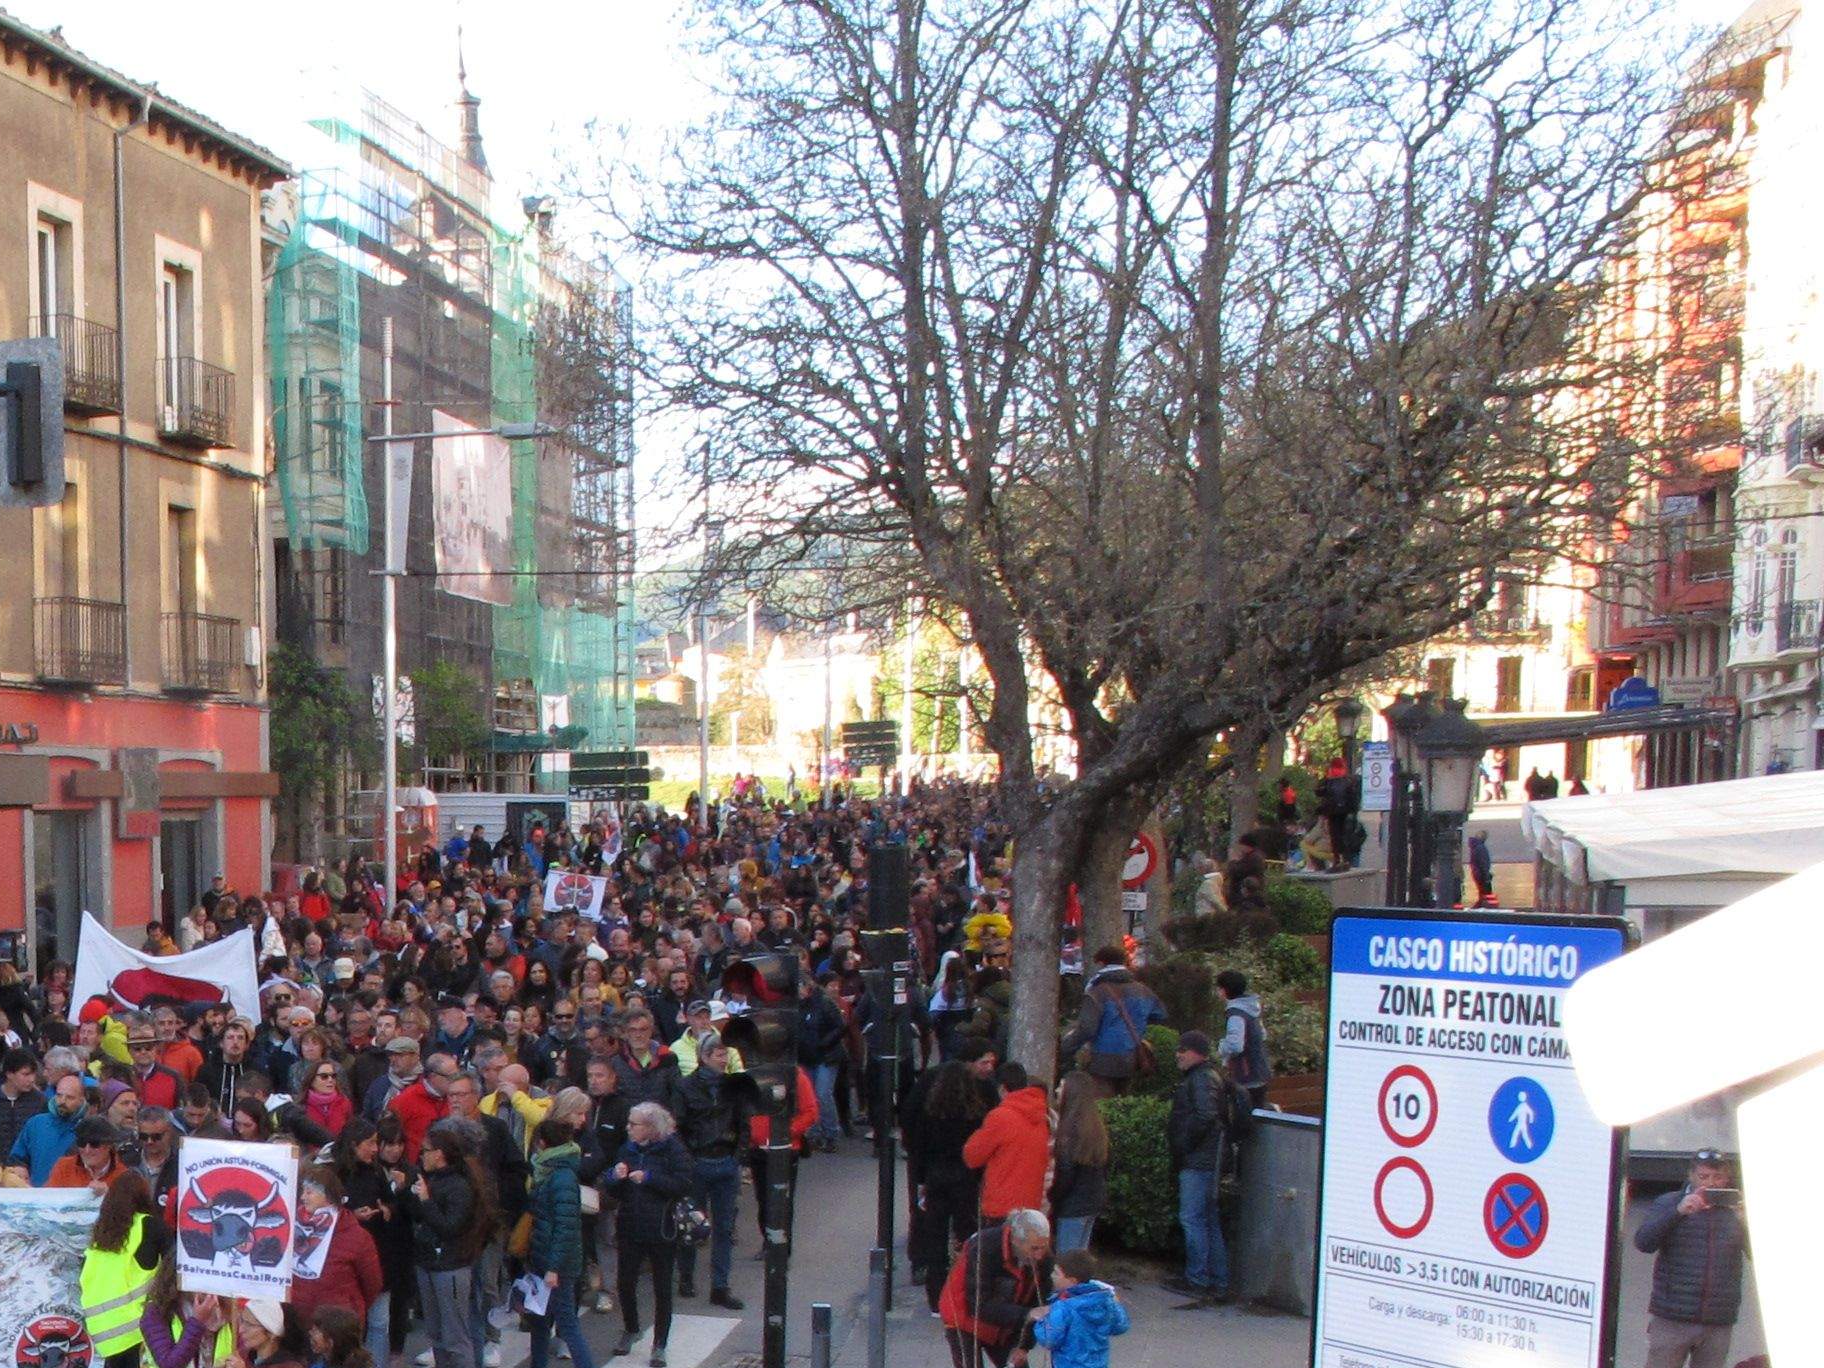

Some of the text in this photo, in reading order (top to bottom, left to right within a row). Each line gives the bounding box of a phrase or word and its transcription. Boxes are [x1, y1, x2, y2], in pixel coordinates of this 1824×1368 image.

[1369, 935, 1578, 980] CASCO HISTÓRICO
[1378, 984, 1561, 1028] ZONA PEATONAL
[1339, 1020, 1573, 1060] CONTROL DE ACCESO CON CÁMA
[1392, 1092, 1420, 1121] 10
[1331, 1243, 1402, 1275] VEHÍCULOS
[1451, 1267, 1480, 1289] CON
[1483, 1273, 1591, 1310] AUTORIZACIÓN
[1368, 1296, 1394, 1315] Carga
[1397, 1304, 1404, 1317] y
[1456, 1304, 1485, 1323] 06:00
